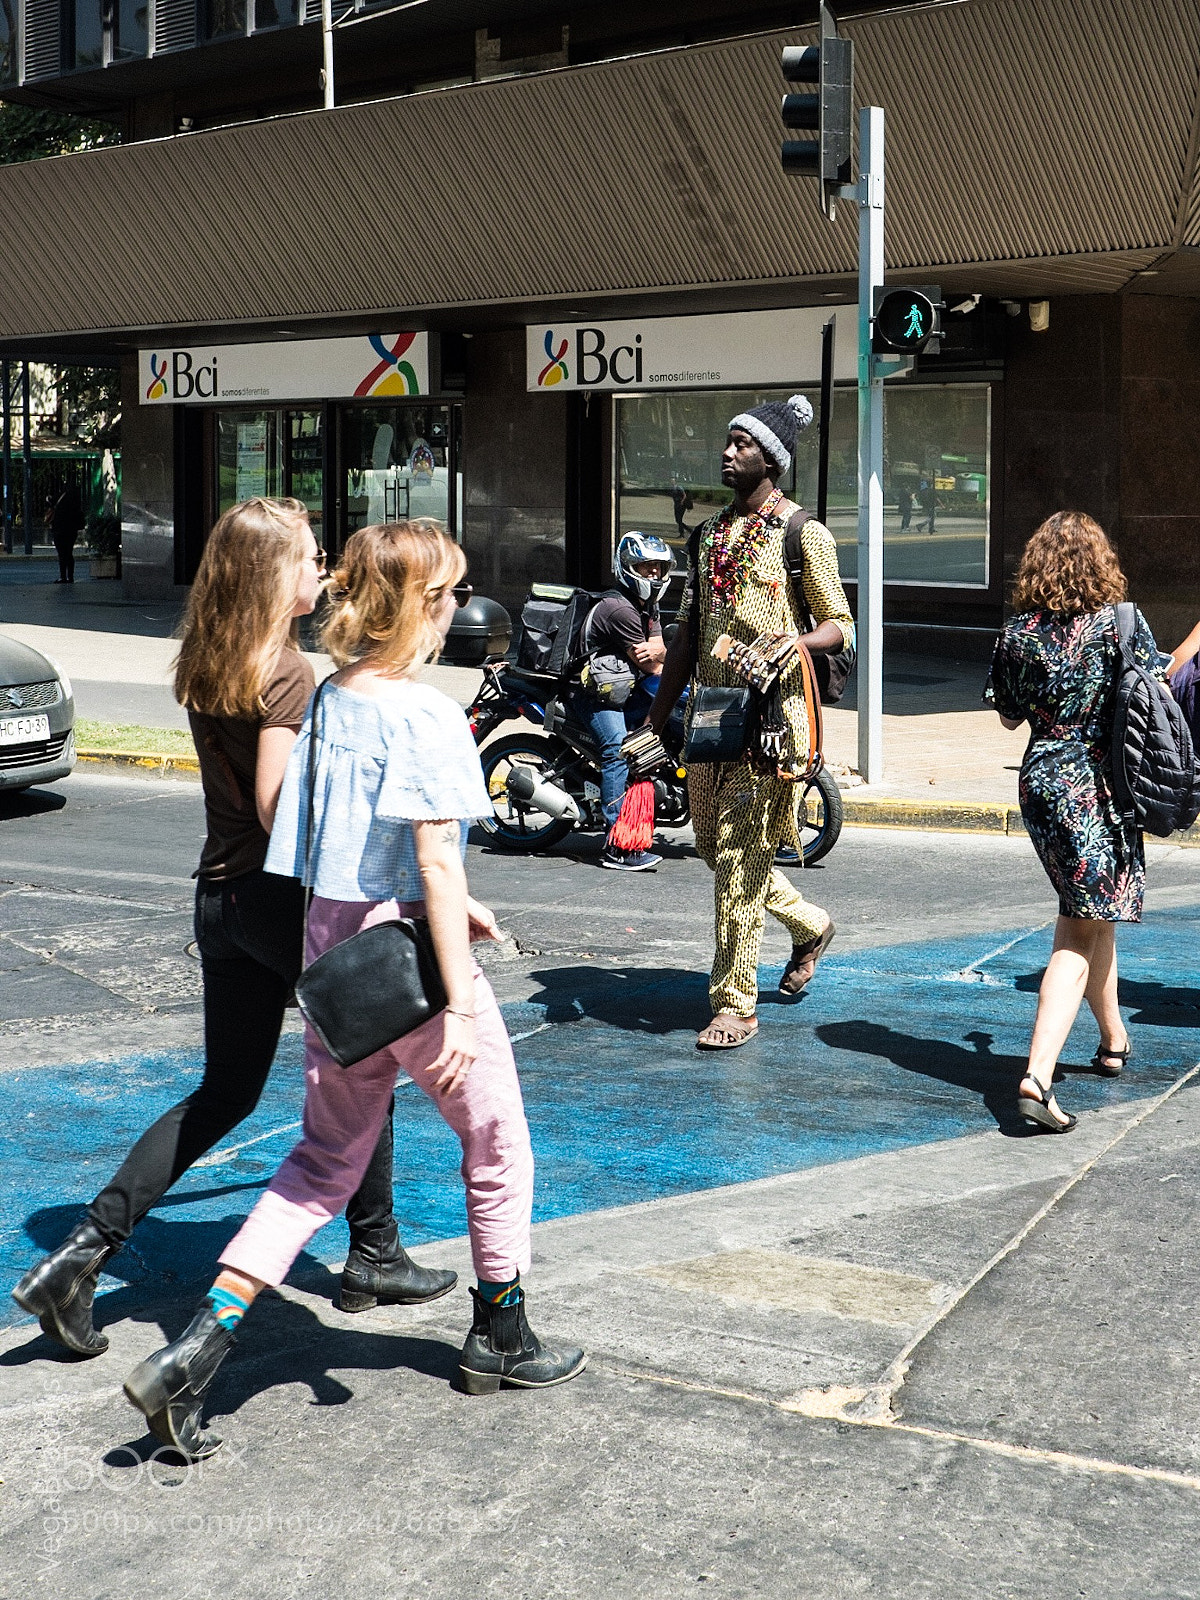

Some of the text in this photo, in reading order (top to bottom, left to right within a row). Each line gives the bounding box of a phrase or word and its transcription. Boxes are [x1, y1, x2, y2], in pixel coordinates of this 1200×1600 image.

[172, 351, 218, 399] Bci
[576, 328, 721, 385] Bci somosdiferentes
